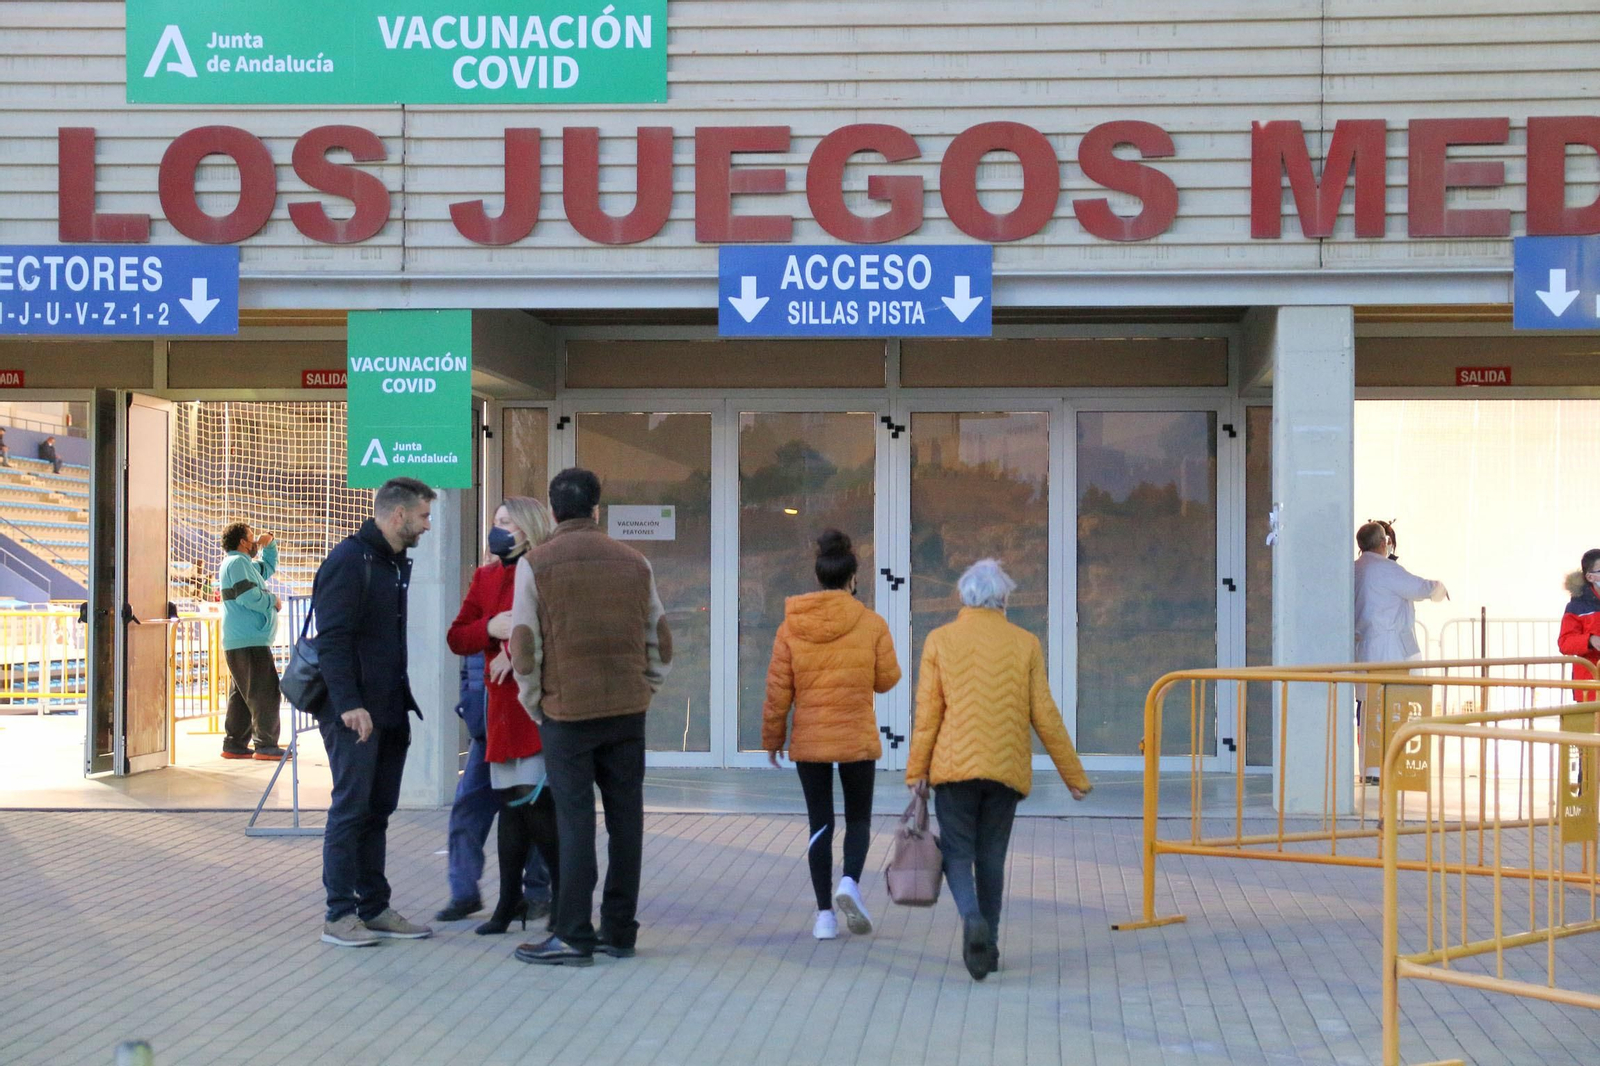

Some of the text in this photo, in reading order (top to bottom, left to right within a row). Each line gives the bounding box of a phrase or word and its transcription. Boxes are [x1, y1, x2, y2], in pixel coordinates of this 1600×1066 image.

[377, 5, 652, 50] VACUNACIÓN
[206, 32, 264, 50] Junta
[206, 52, 334, 73] de Andalucía
[452, 56, 580, 90] COVID
[58, 115, 1600, 246] LOS JUEGOS MED
[780, 253, 932, 291] ACCESO
[787, 300, 925, 325] SILLAS PISTA
[350, 352, 467, 372] VACUNACIÓN
[306, 373, 347, 385] SALIDA
[382, 378, 436, 393] COVID
[1460, 370, 1506, 383] SALIDA
[393, 442, 422, 451] Junta
[393, 452, 458, 463] de Andalucía
